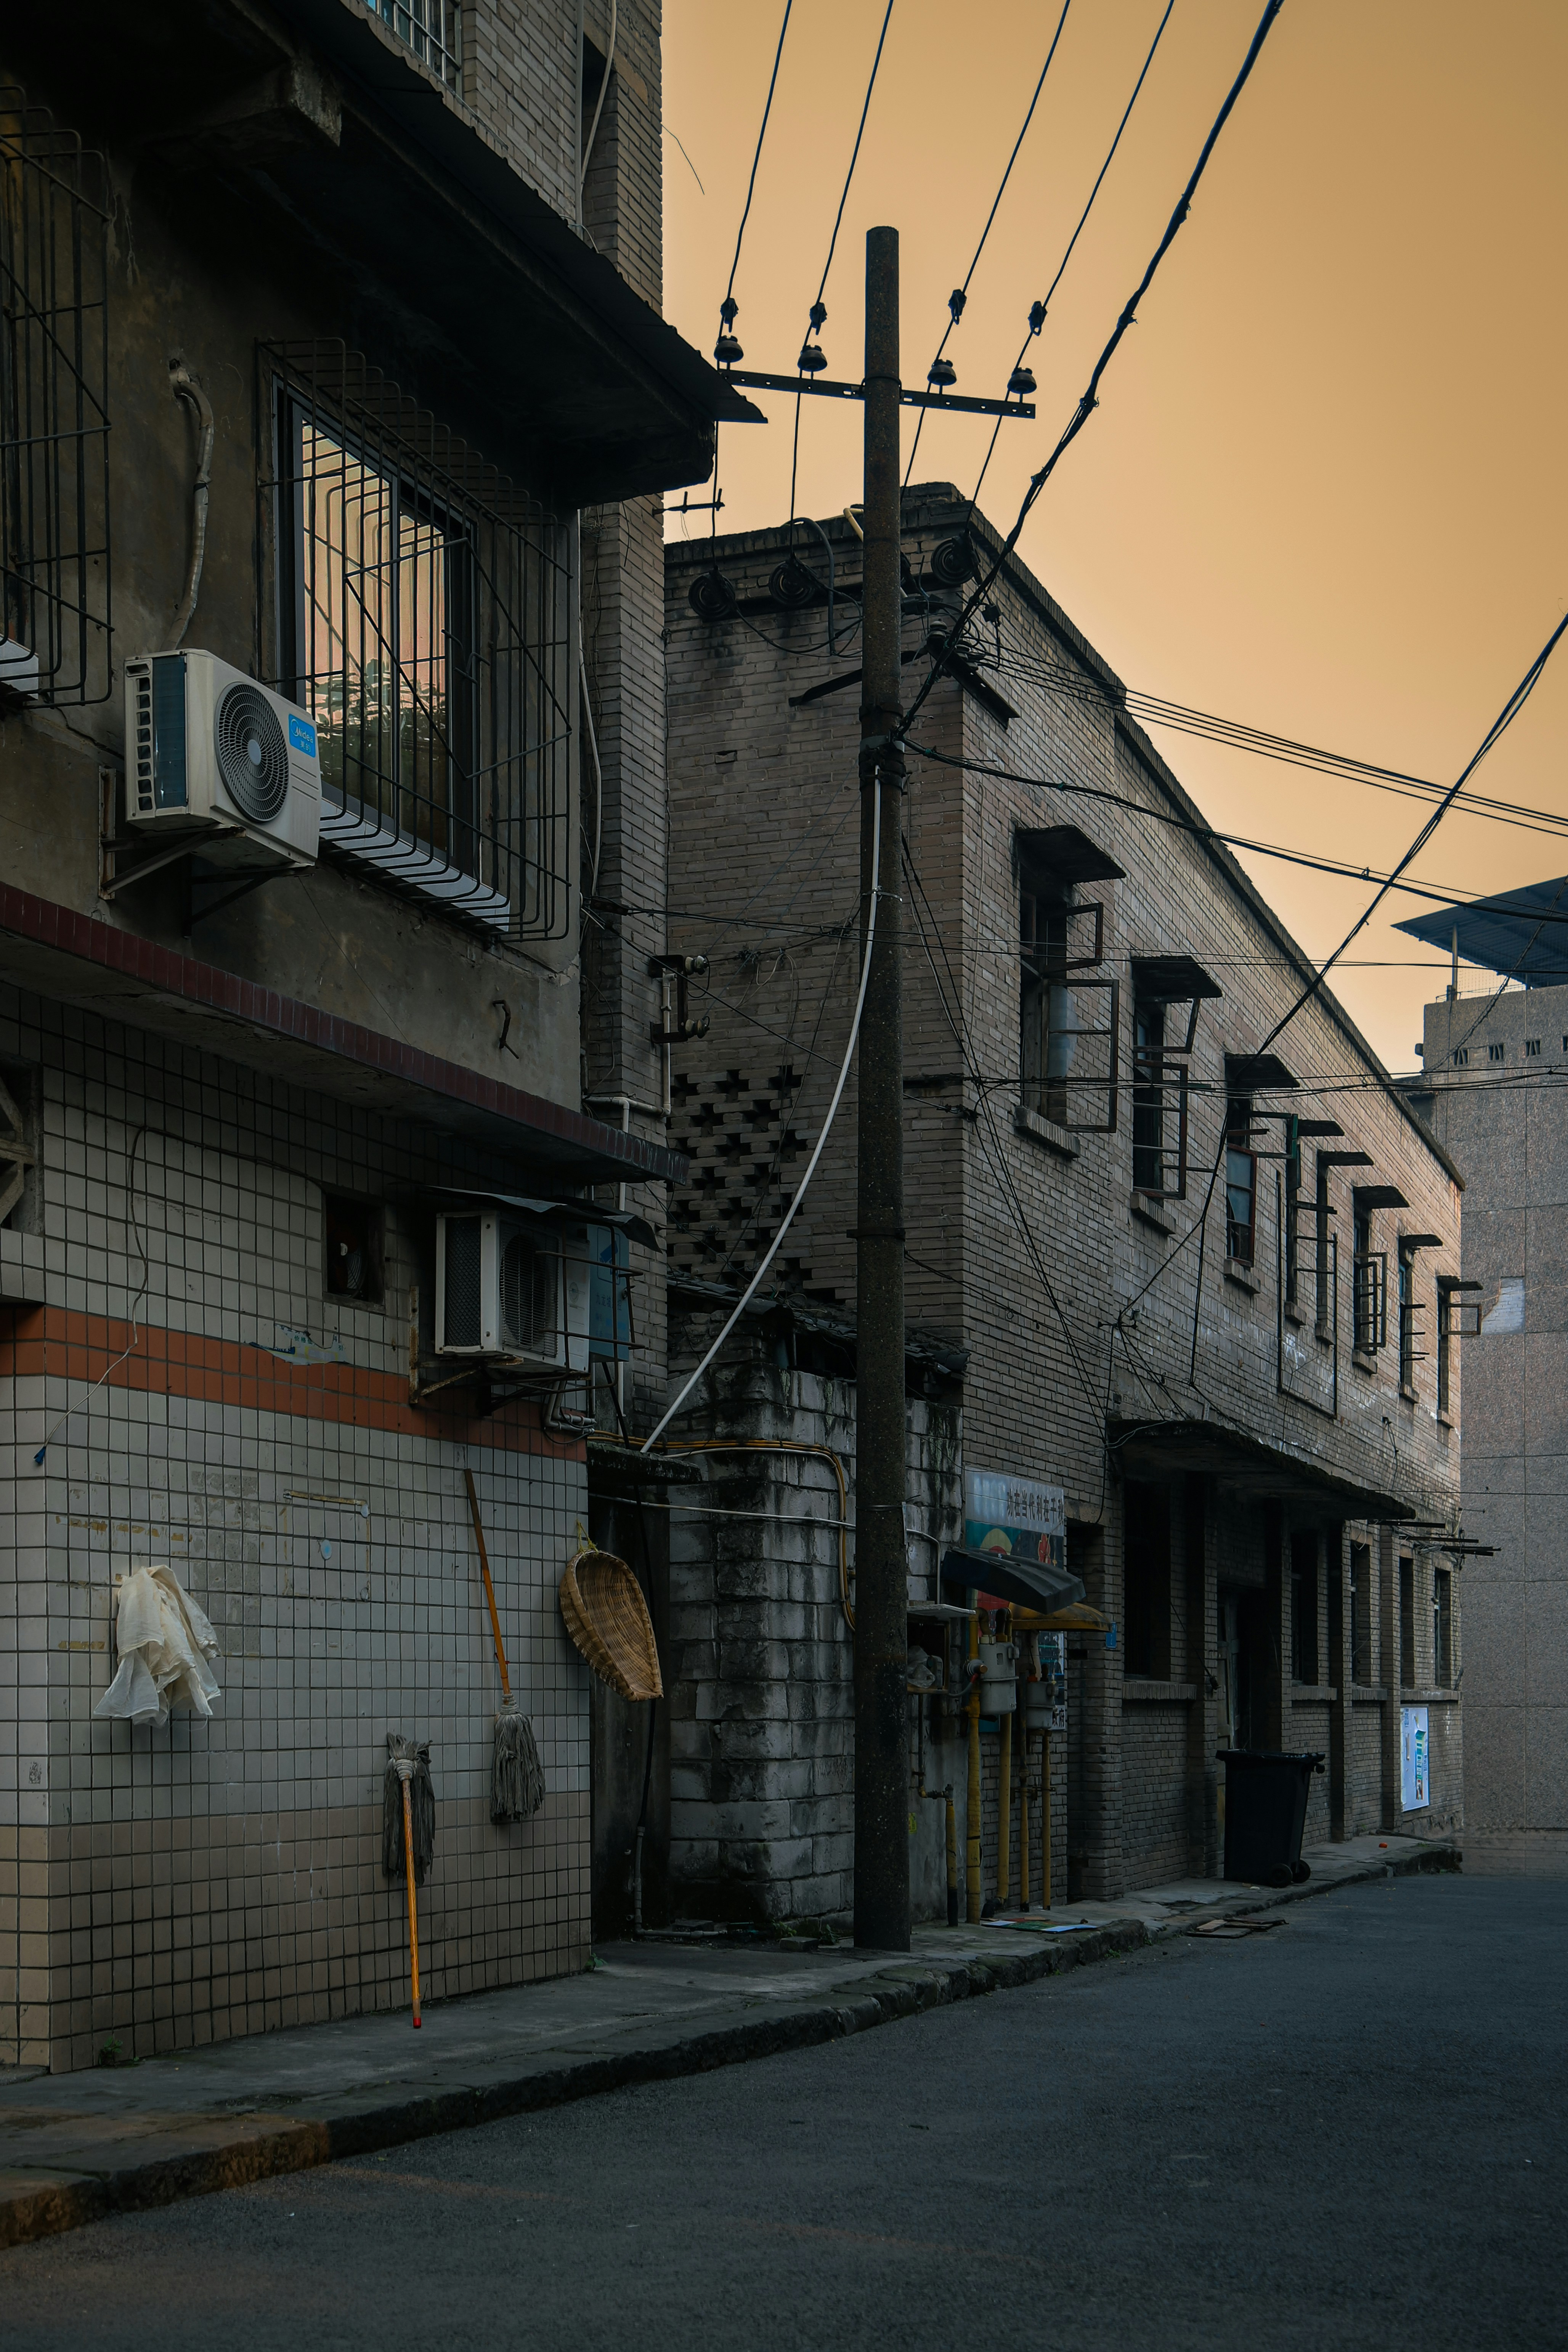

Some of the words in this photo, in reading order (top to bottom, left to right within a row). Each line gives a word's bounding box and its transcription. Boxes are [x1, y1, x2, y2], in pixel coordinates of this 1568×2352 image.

[291, 719, 313, 743] Midea
[300, 740, 311, 752] 美的
[596, 1292, 622, 1311] 九龙坡控
[1007, 1488, 1064, 1525] 功在当代利在千秋
